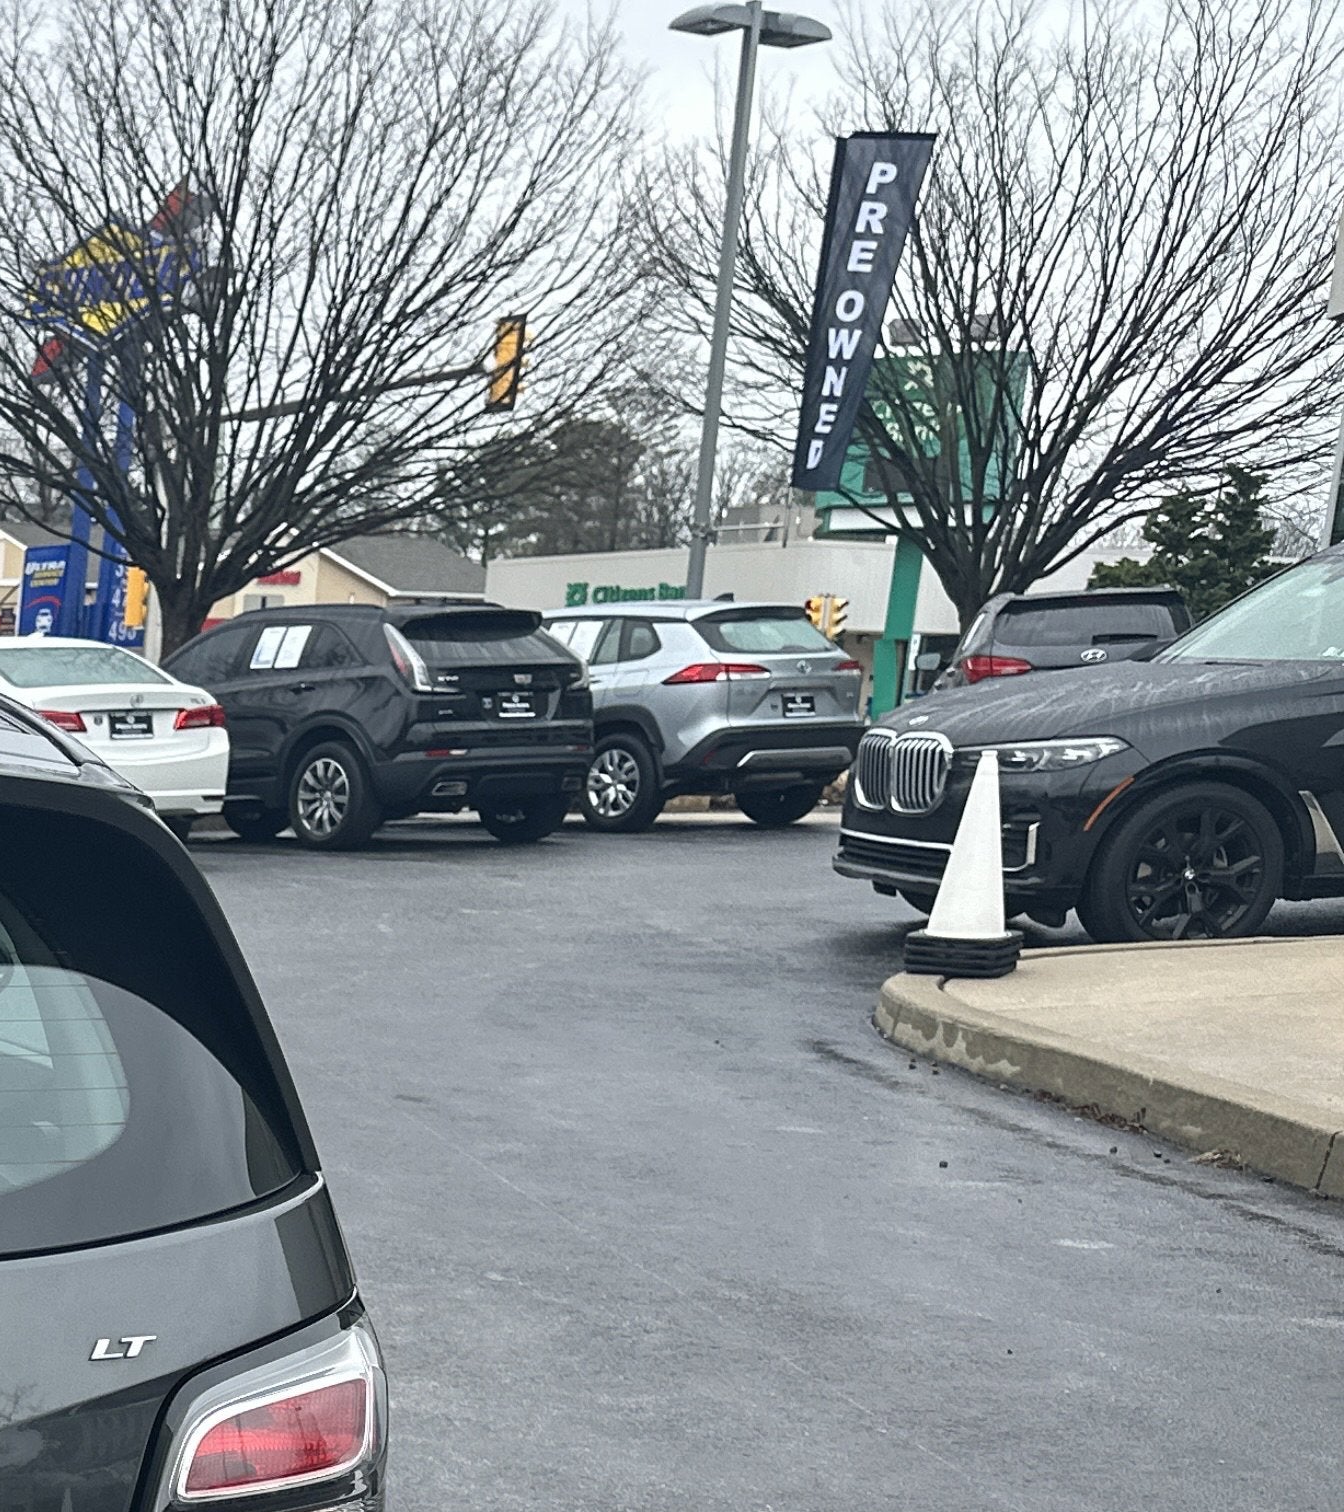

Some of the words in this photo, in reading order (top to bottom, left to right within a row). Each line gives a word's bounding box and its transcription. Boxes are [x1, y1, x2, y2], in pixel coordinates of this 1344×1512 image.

[847, 162, 897, 273] PRE
[806, 289, 862, 470] OWNED
[88, 1335, 157, 1361] LT
